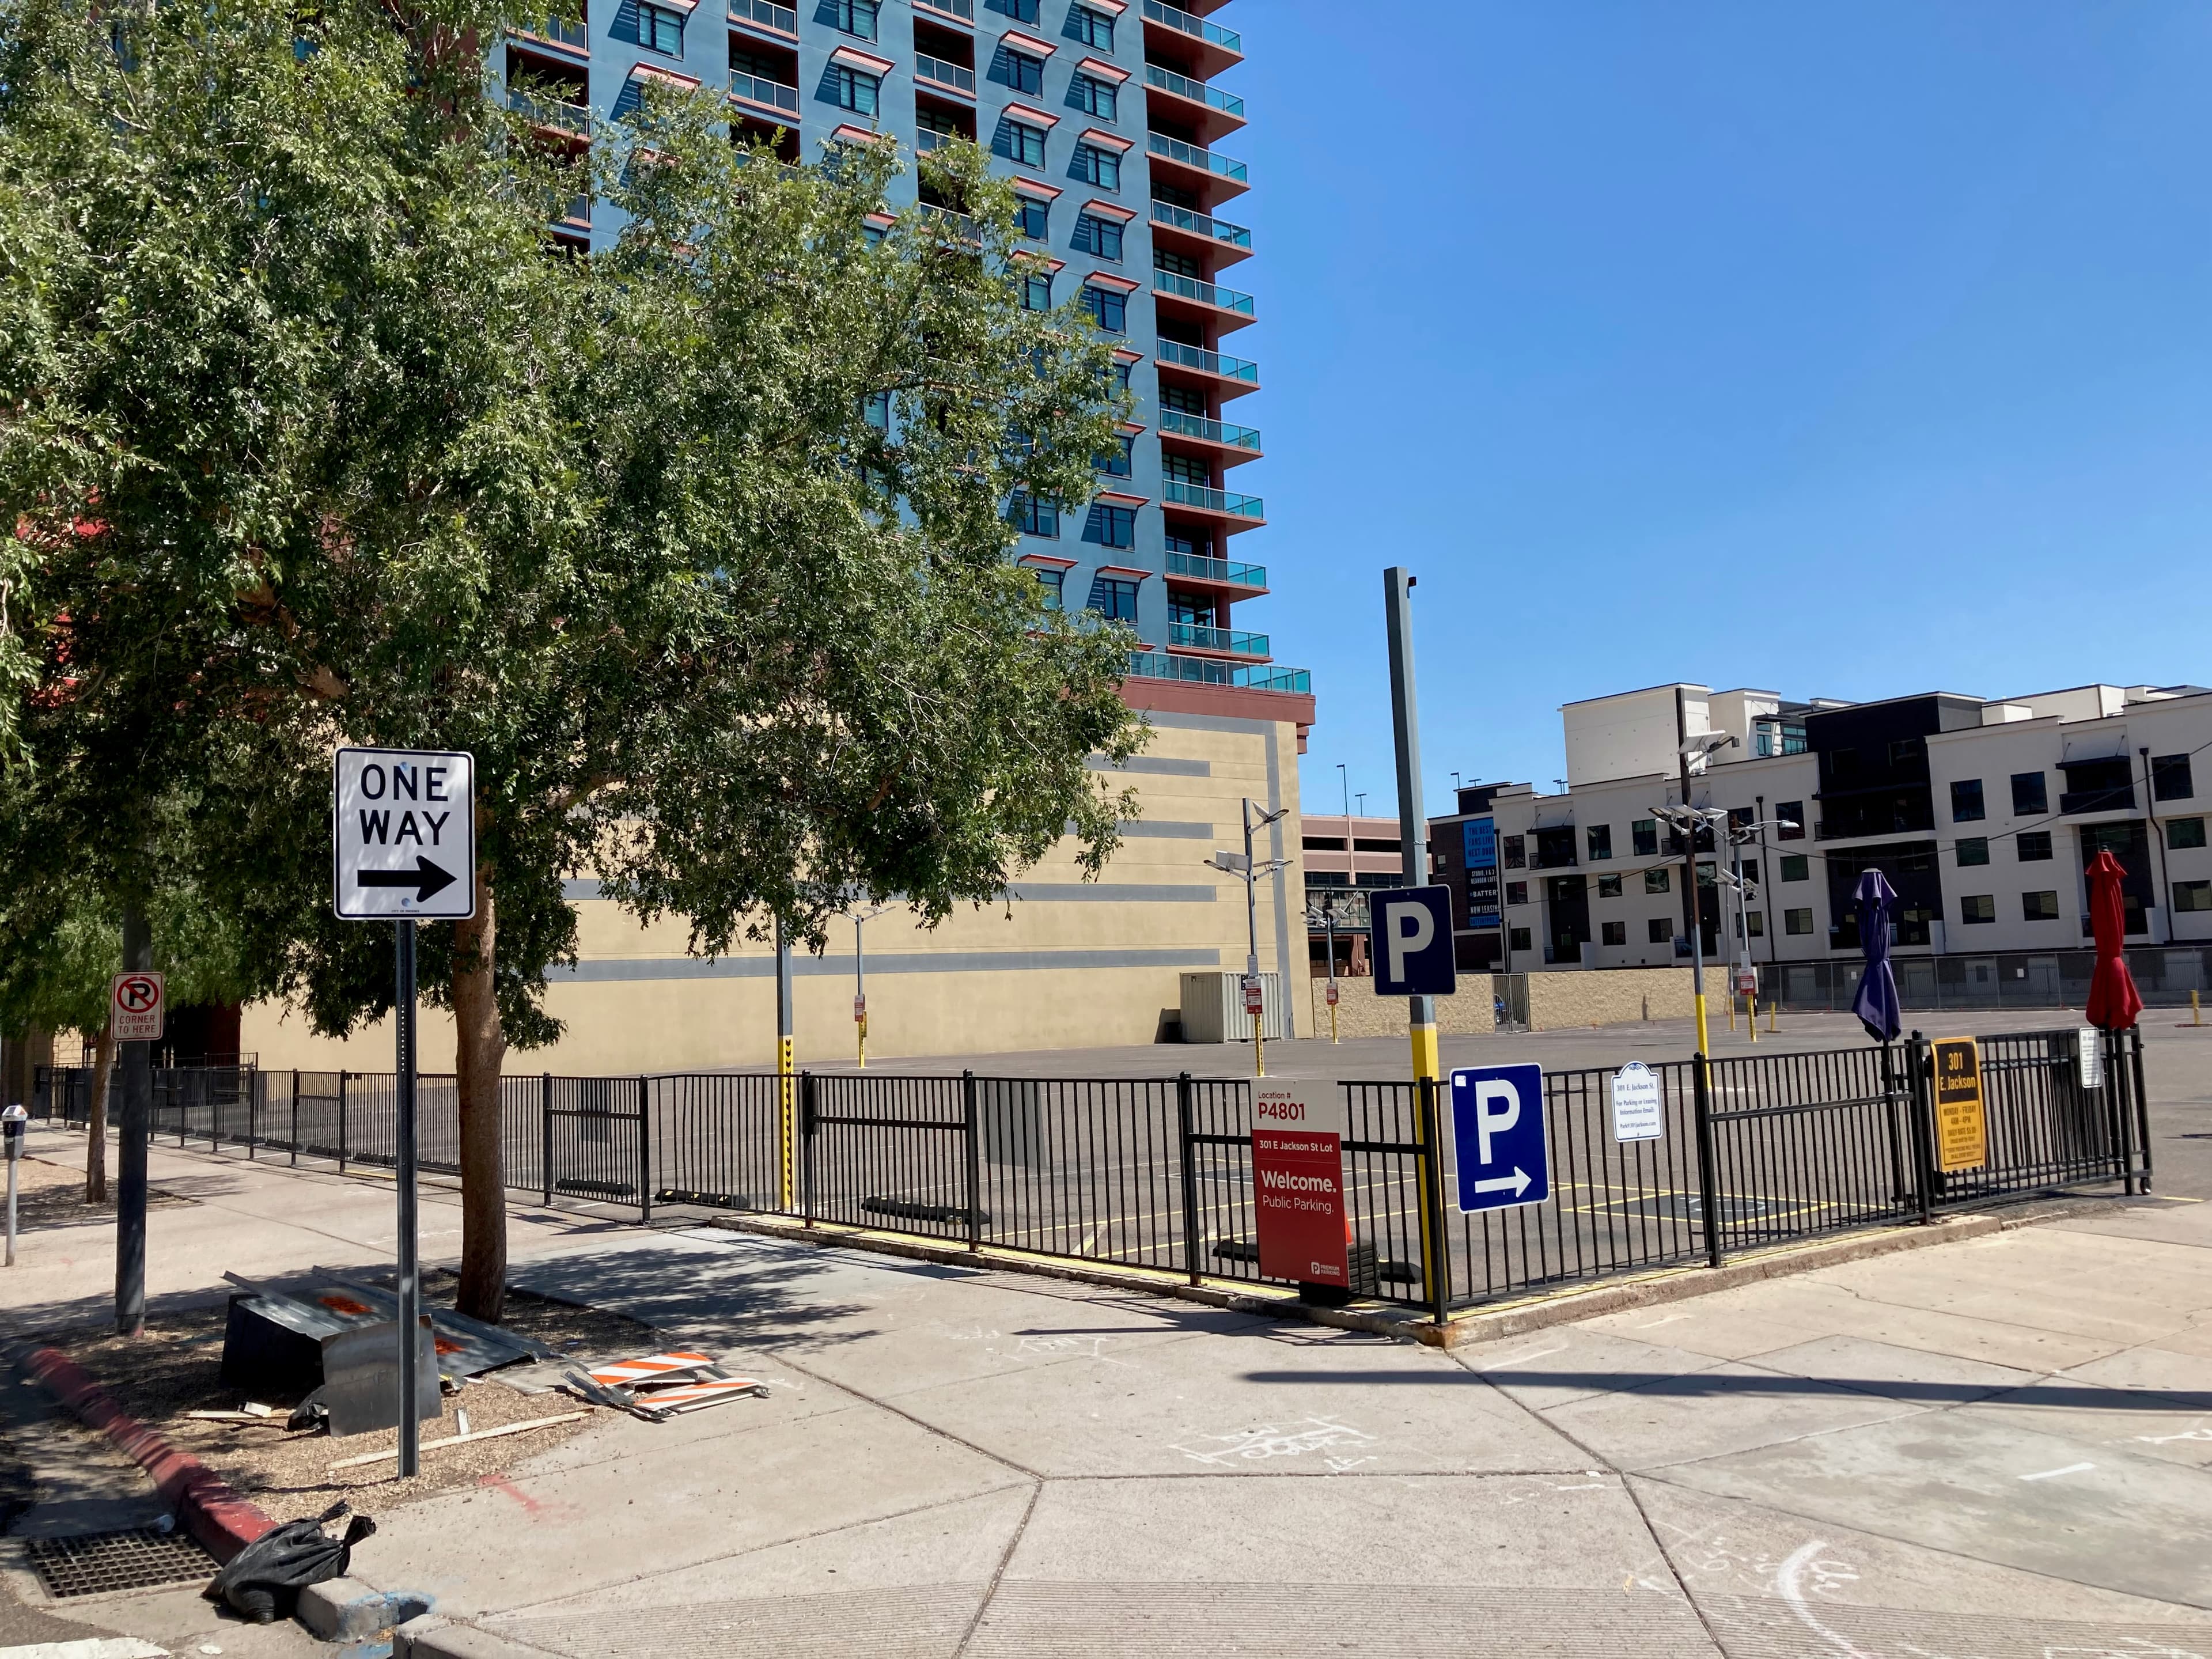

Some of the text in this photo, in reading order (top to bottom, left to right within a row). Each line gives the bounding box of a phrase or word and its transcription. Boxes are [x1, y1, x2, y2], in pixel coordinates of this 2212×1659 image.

[361, 764, 448, 801] ONE
[359, 809, 450, 846] WAY
[1469, 824, 1491, 835] THE BEST
[1483, 835, 1494, 844] LIVE
[1468, 848, 1480, 857] NEXT
[1471, 904, 1498, 914] NOW LEASIN
[1386, 901, 1434, 982] P
[119, 1015, 155, 1024] CORNER
[118, 1025, 156, 1034] TO HERE
[1948, 1052, 1963, 1071] 301
[1632, 1083, 1648, 1092] Jackson
[1940, 1076, 1976, 1091] E. Jackson
[1258, 1091, 1285, 1100] Location
[1258, 1102, 1305, 1120] P4801
[1475, 1079, 1520, 1165] P
[1259, 1139, 1333, 1153] 301 E Jackson St Lot
[1260, 1169, 1336, 1194] Welcome.
[1263, 1195, 1334, 1215] Public Parking.
